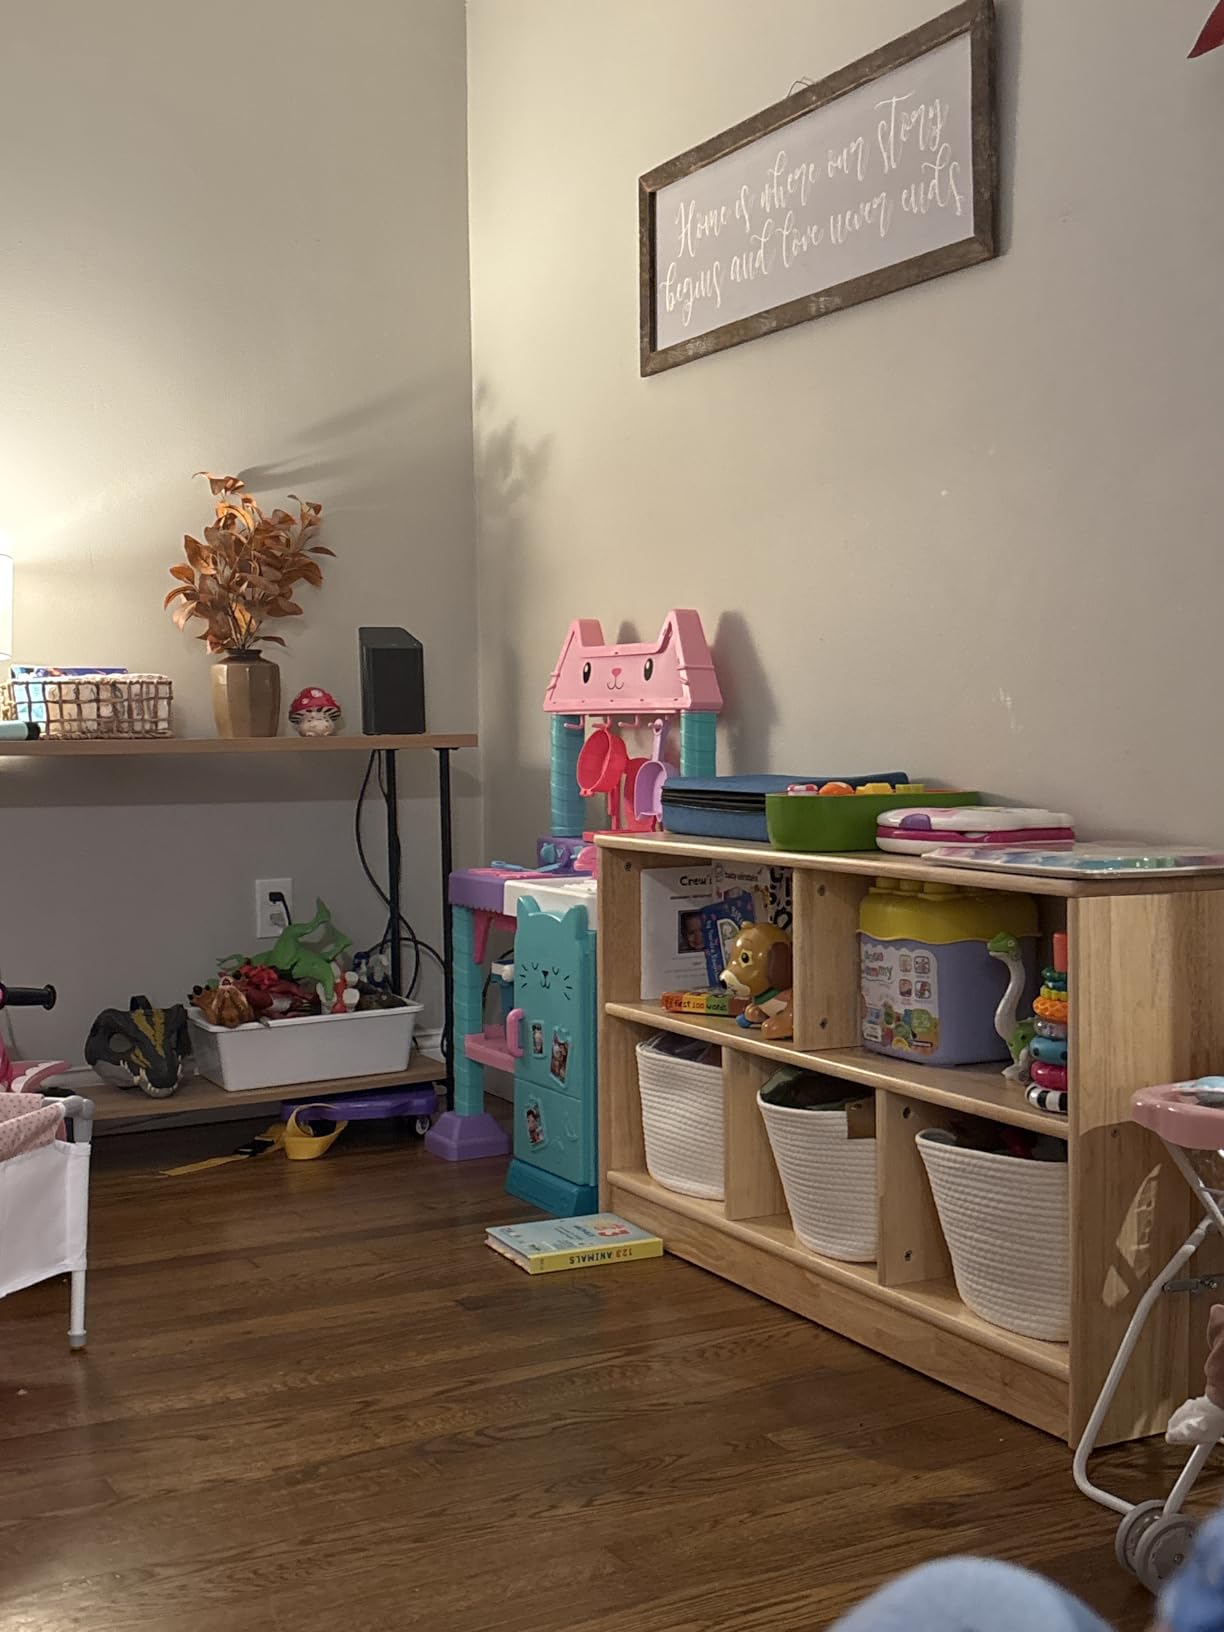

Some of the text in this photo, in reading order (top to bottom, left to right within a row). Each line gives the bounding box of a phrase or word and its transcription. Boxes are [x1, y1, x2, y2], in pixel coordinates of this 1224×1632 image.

[674, 92, 948, 258] Home is where our story
[658, 142, 963, 327] begins and love never ends
[692, 1000, 705, 1009] 100
[569, 1247, 633, 1265] 123 ANIMALS
